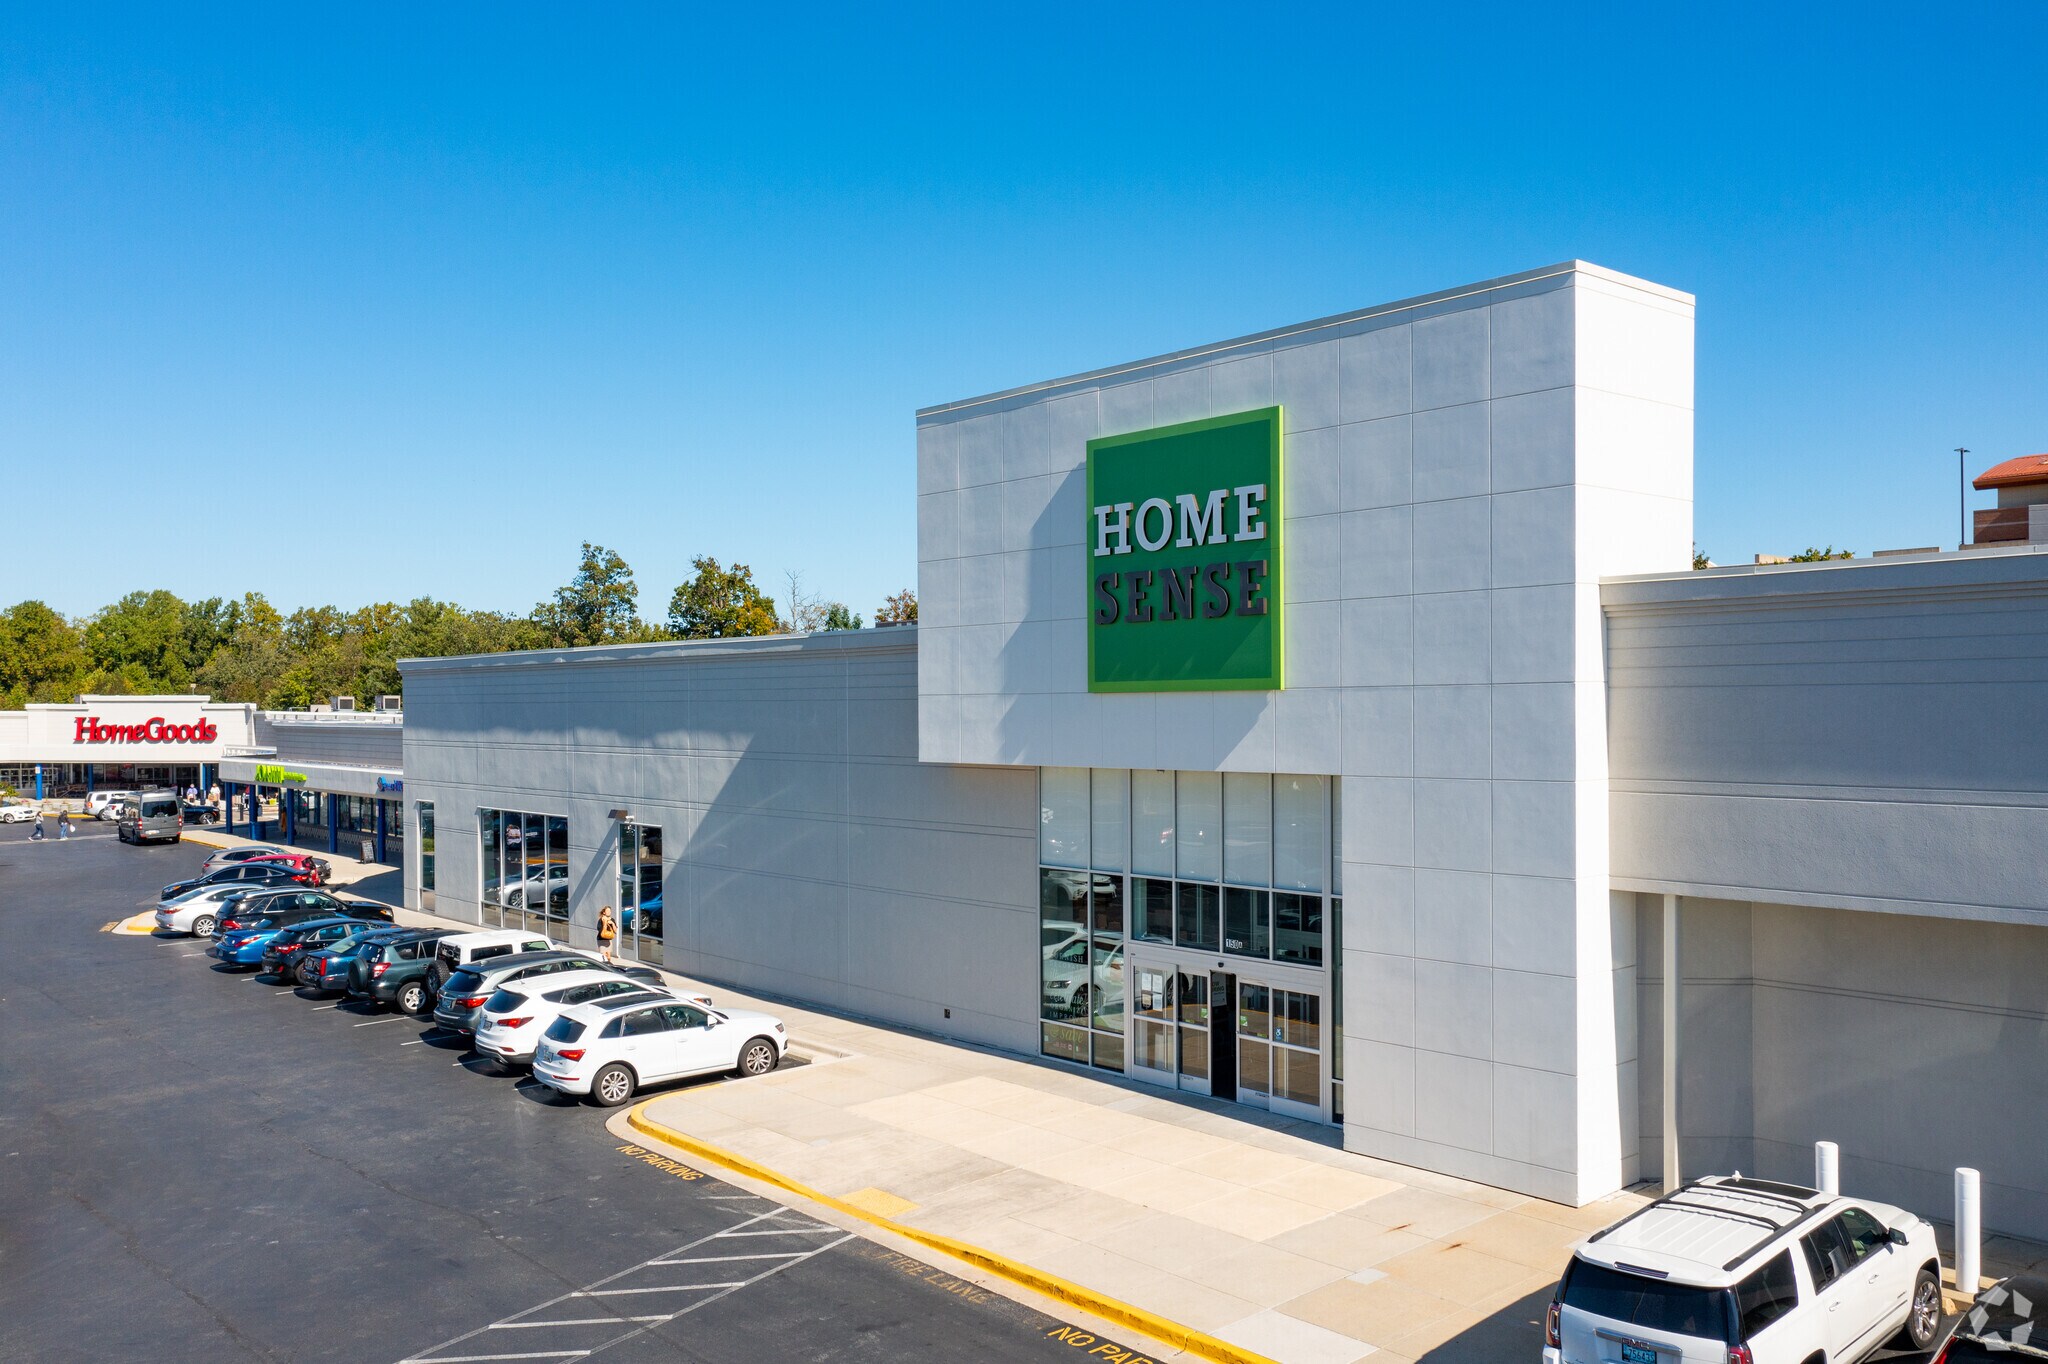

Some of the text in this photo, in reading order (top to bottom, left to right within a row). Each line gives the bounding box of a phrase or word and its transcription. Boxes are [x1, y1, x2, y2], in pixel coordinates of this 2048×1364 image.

[1094, 484, 1266, 557] HOME
[1095, 560, 1268, 625] SENSE
[74, 717, 218, 743] HomeGoods
[615, 1144, 704, 1181] NO PARKING
[1047, 1326, 1096, 1347] NO
